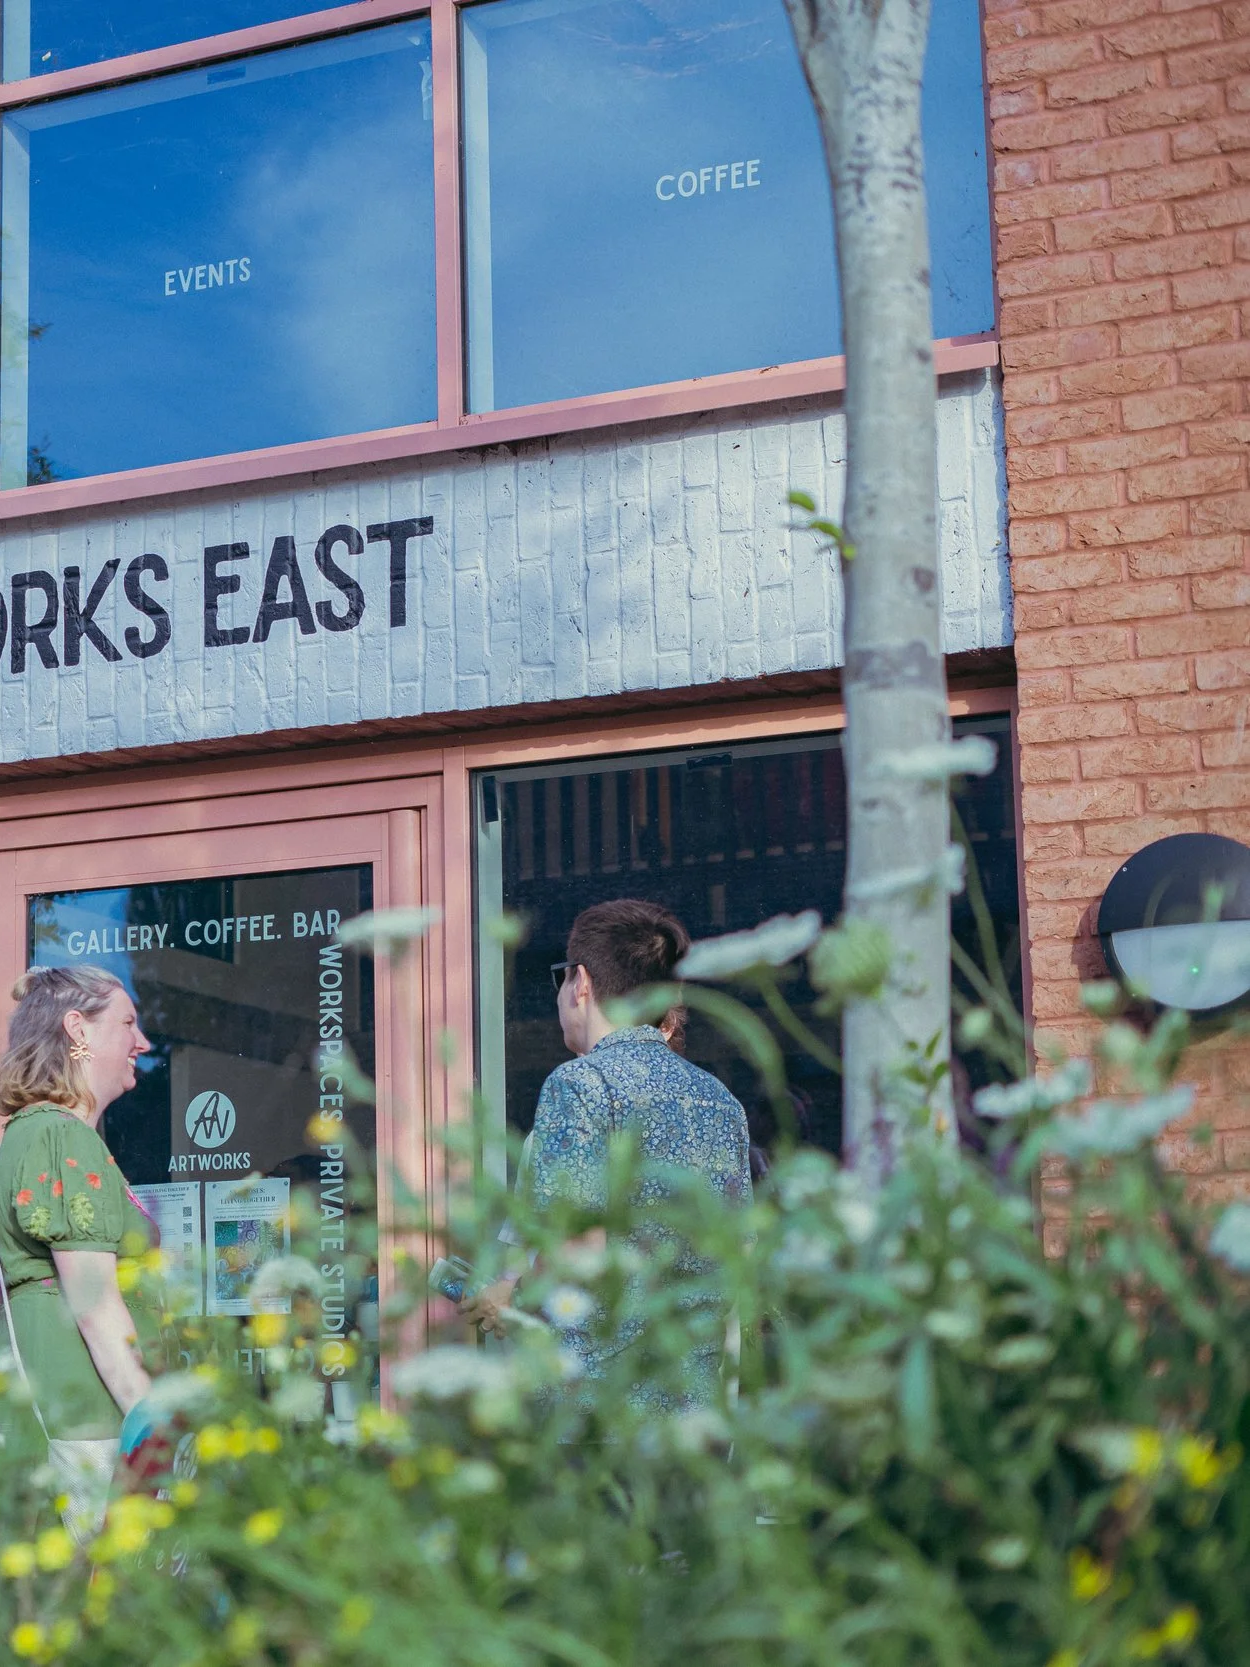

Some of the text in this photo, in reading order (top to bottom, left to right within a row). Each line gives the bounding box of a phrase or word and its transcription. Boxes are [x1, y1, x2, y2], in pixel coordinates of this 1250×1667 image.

[655, 159, 761, 201] COFFEE
[164, 257, 251, 296] EVENTS
[203, 516, 434, 647] EAST
[67, 909, 341, 956] GALLERY. COFFEE. BAR
[168, 1152, 251, 1172] ARTWORKS
[320, 1144, 345, 1251] PRIVATE
[321, 1264, 346, 1376] STUDIOS
